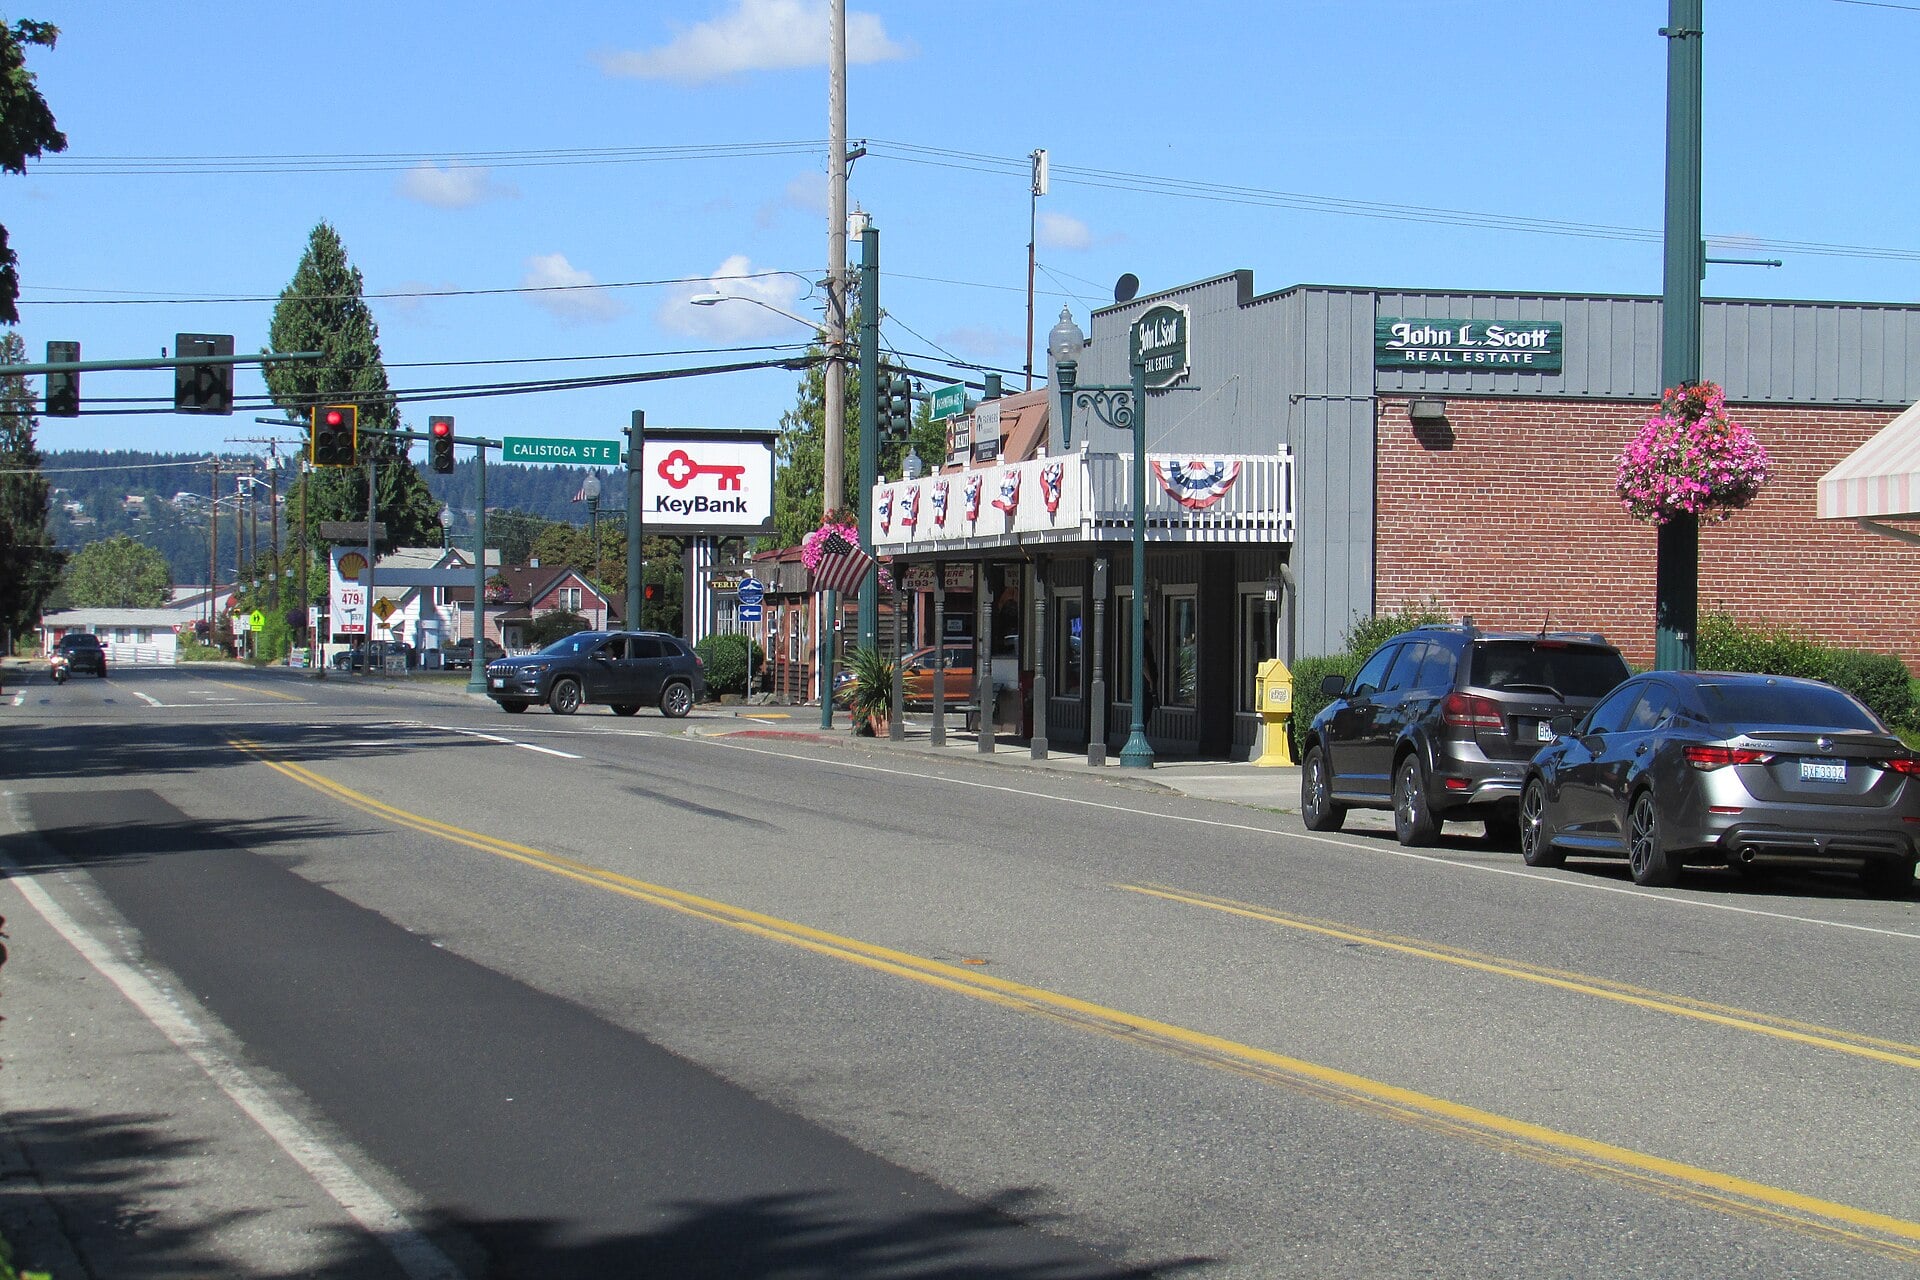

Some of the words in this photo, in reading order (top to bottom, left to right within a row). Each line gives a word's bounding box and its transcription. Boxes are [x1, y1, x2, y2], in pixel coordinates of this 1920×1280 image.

[1138, 323, 1154, 356] John
[1385, 323, 1451, 347] John
[1483, 325, 1549, 348] Scott
[1145, 359, 1154, 373] EAL
[1155, 355, 1173, 371] ESTATE
[1405, 351, 1453, 362] REAL
[1462, 352, 1533, 363] ESTATE
[513, 444, 577, 457] CALISTOGA
[583, 447, 597, 458] ST
[603, 447, 610, 458] E
[656, 495, 748, 516] KeyBank
[341, 593, 360, 605] 479
